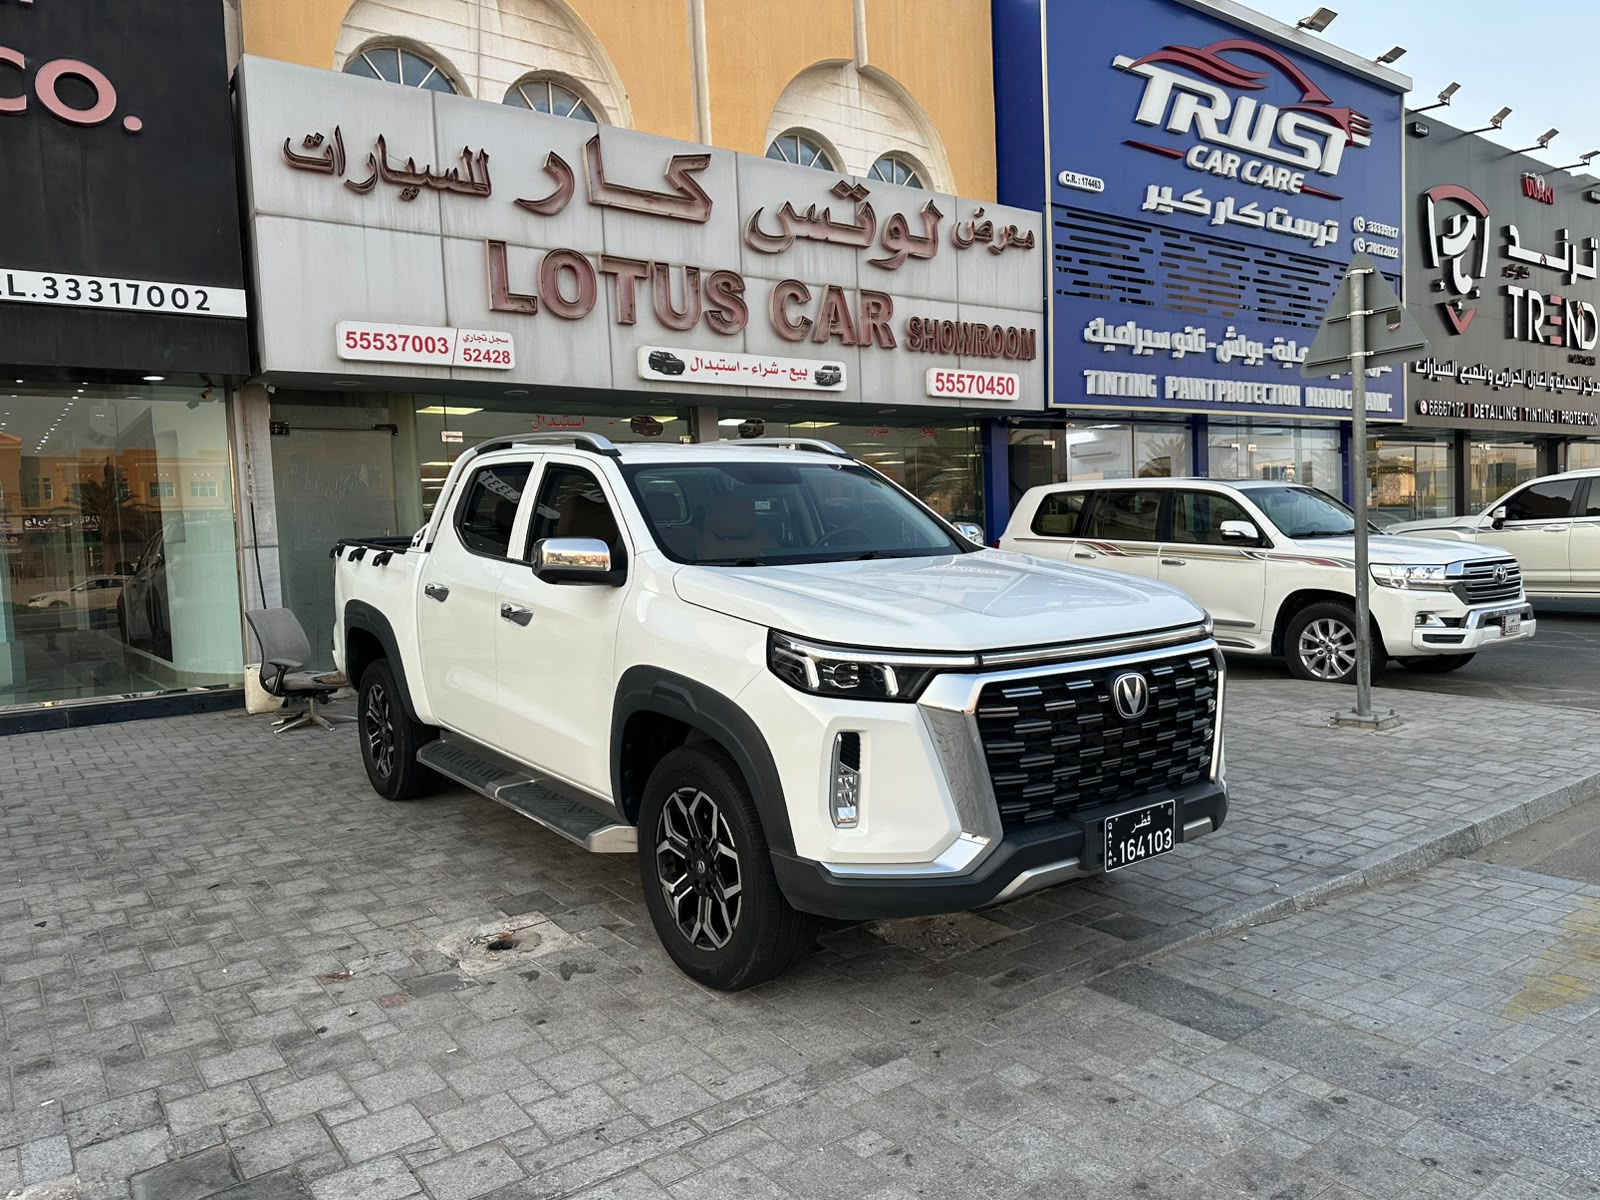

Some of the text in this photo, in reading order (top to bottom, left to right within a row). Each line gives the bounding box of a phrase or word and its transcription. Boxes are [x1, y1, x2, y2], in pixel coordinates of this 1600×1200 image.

[1112, 54, 1371, 176] TRUST
[1186, 145, 1305, 195] CAR CARE
[281, 124, 1036, 271] معرض لوتس كار للسيارات
[1142, 184, 1339, 248] ترست كار كير
[1507, 224, 1599, 285] ترند
[0, 273, 211, 312] L.33317002
[485, 239, 1037, 361] LOTUS CAR SHOWROOM
[1507, 284, 1598, 350] TREND
[345, 330, 449, 355] 55537003
[462, 333, 488, 343] تجاري
[463, 348, 511, 365] 52428
[689, 356, 809, 382] بيع شراء استبدال
[1415, 357, 1458, 382] السيارات
[935, 372, 1015, 396] 55570450
[1083, 369, 1157, 398] TINTING
[1305, 386, 1393, 412] NANOCAMIC
[532, 414, 585, 432] استبدال
[1428, 400, 1599, 425] 66667172 DETAILING TINTING PROTECTION
[1130, 811, 1151, 833] قطر
[1119, 828, 1172, 863] 164103
